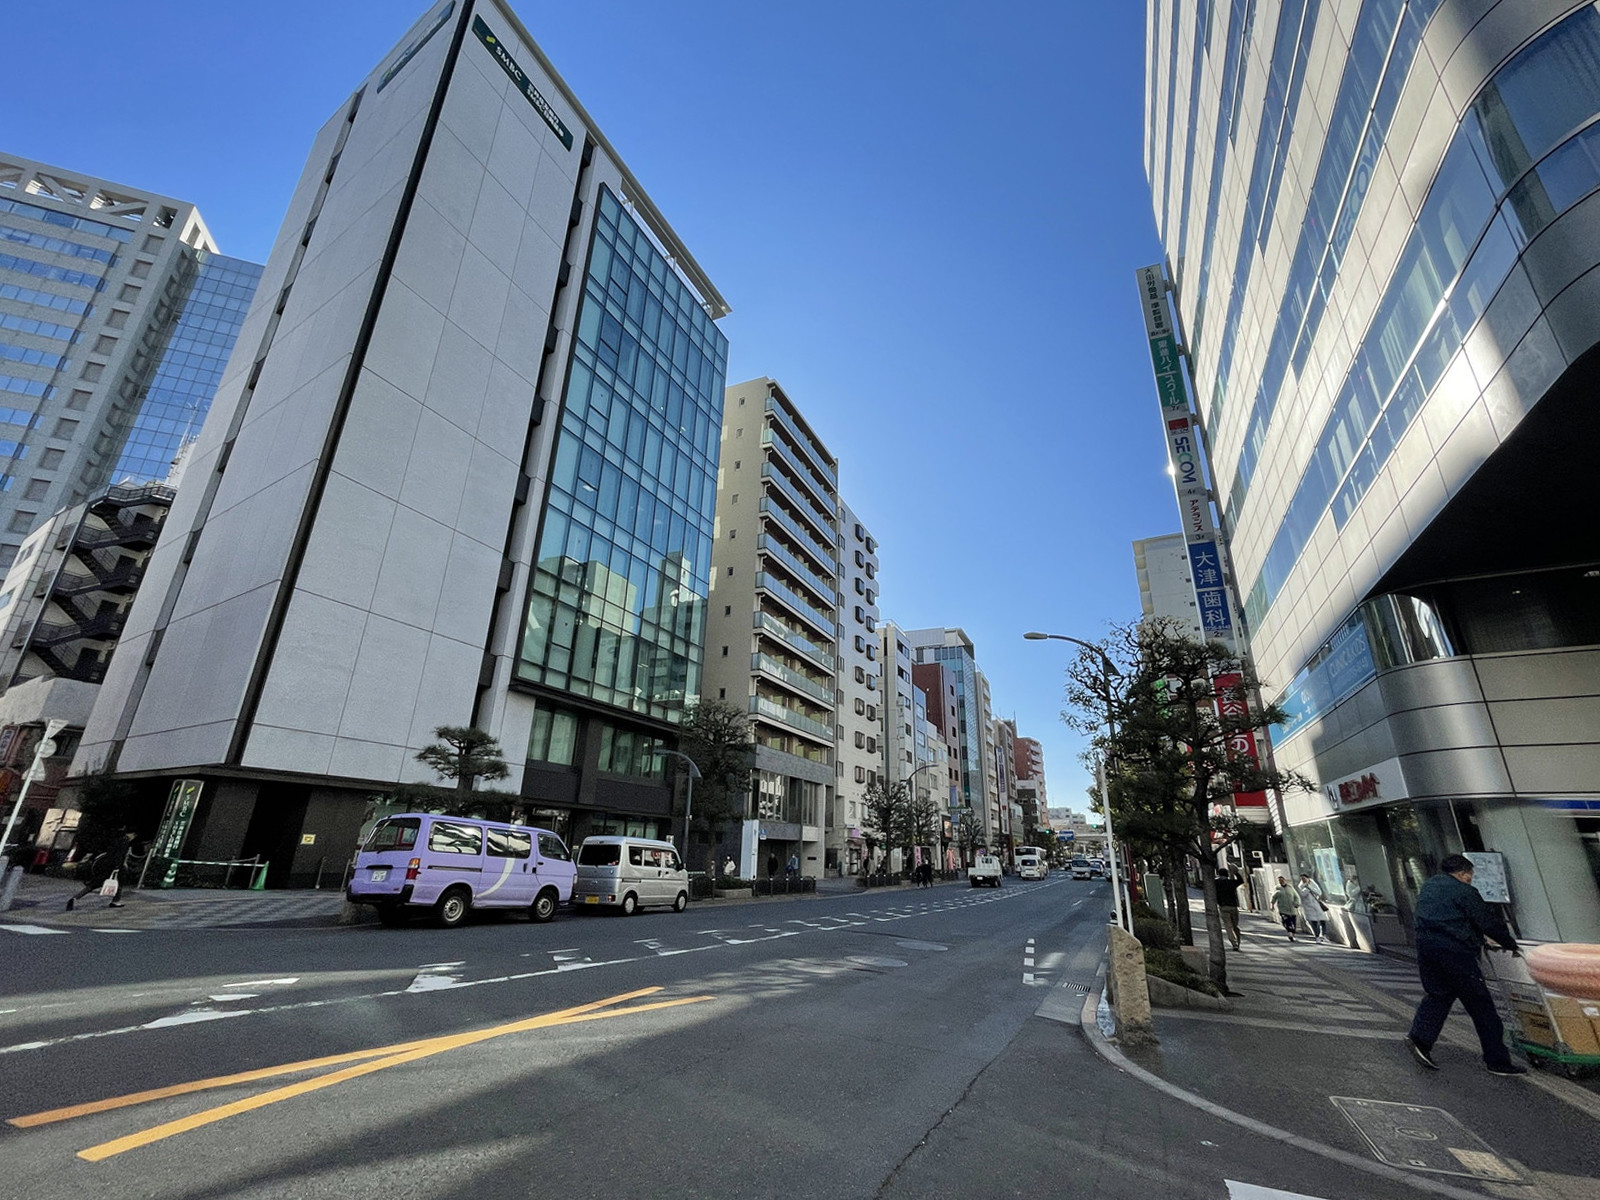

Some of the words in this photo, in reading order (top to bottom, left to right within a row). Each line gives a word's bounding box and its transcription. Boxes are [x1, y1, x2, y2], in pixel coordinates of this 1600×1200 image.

[495, 46, 522, 81] SMBC
[1174, 437, 1197, 484] SECOM
[1195, 551, 1226, 626] 大津歯科
